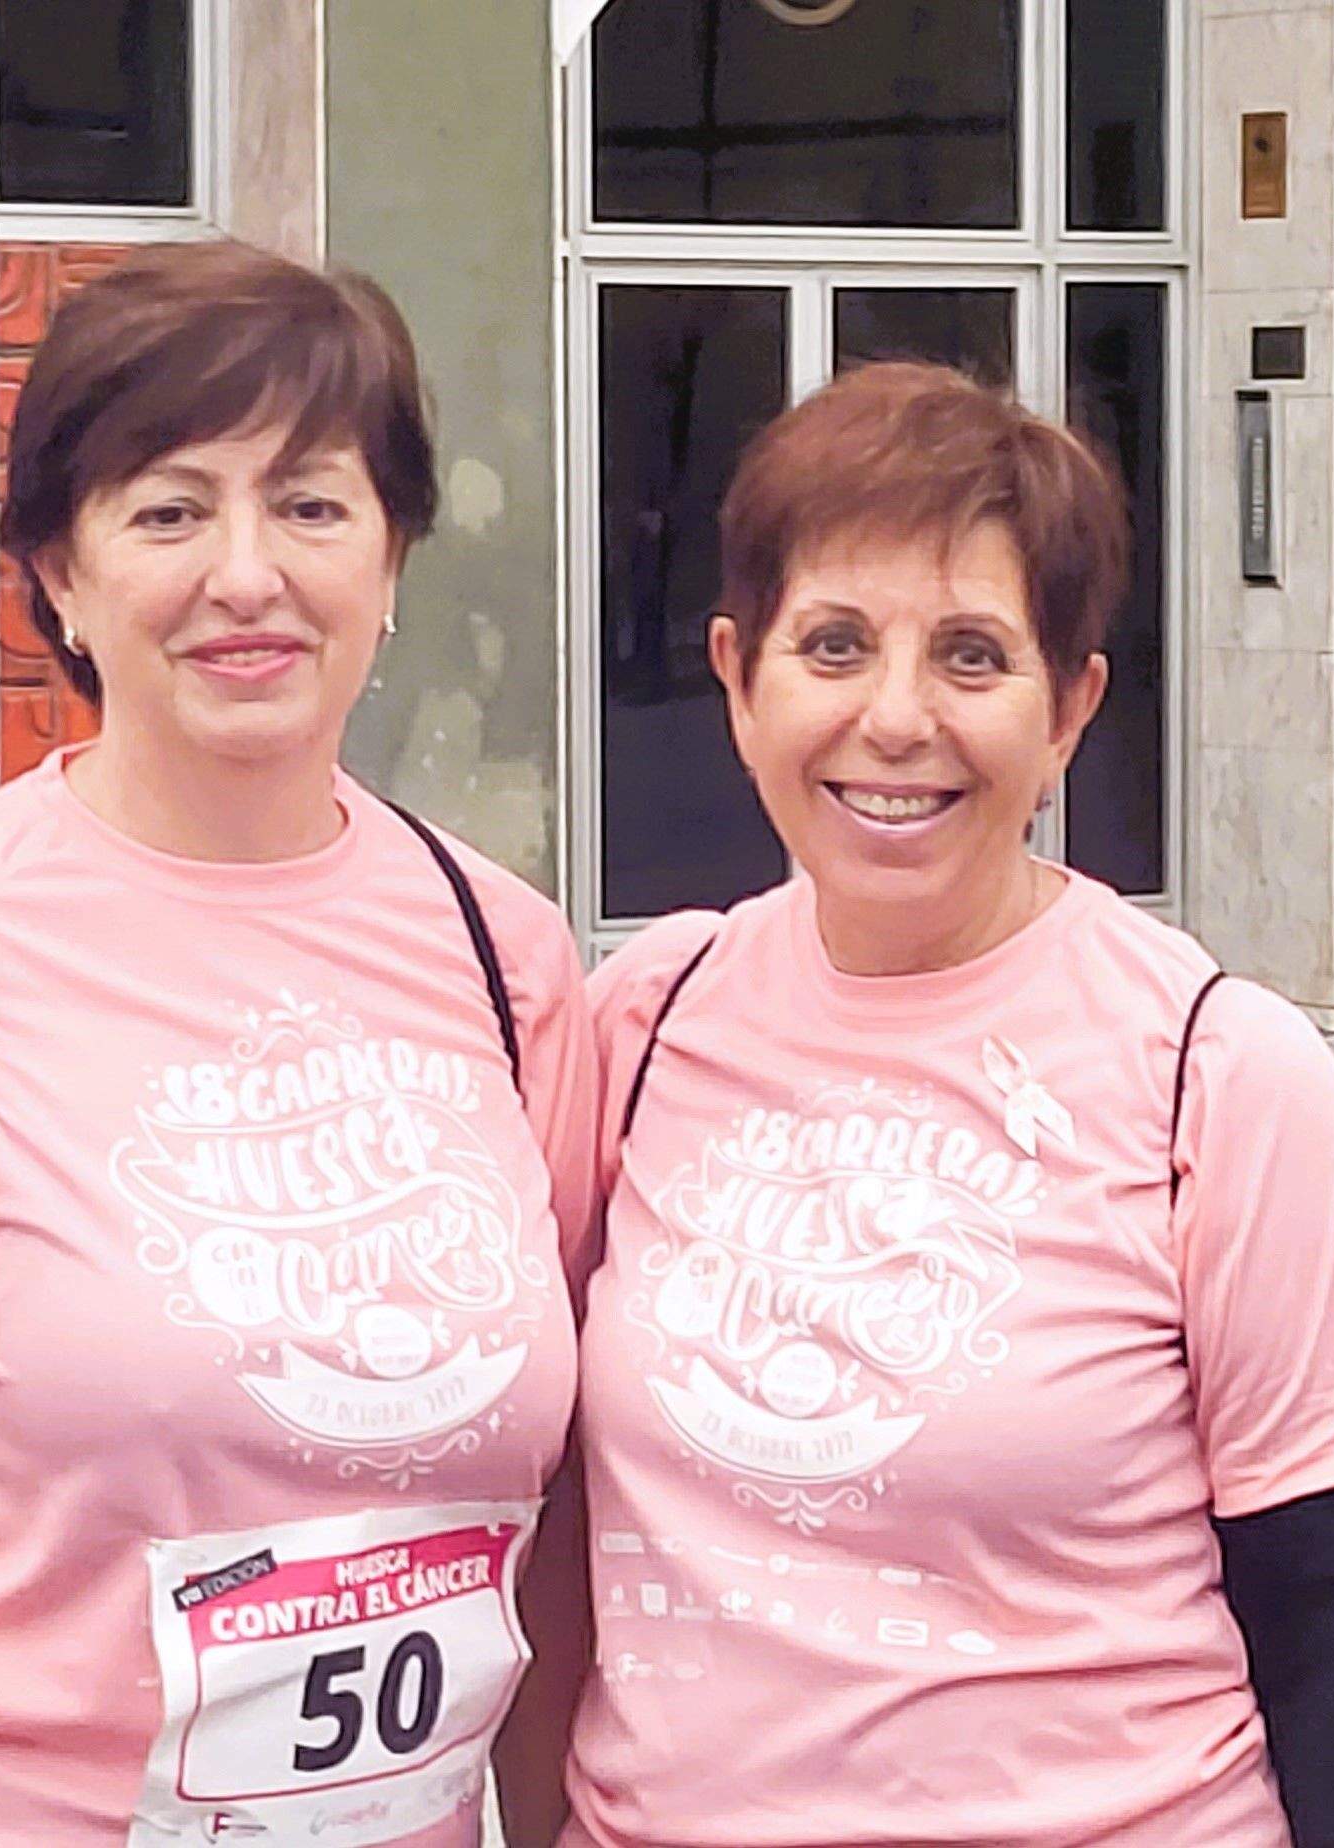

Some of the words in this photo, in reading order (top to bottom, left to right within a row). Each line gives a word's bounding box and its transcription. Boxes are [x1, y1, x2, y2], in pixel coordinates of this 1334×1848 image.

[209, 1594, 359, 1642] CONTRA
[365, 1588, 397, 1616] EL
[399, 1554, 491, 1605] CÁNCER
[335, 1548, 411, 1588] HUESCA
[292, 1630, 445, 1772] 50
